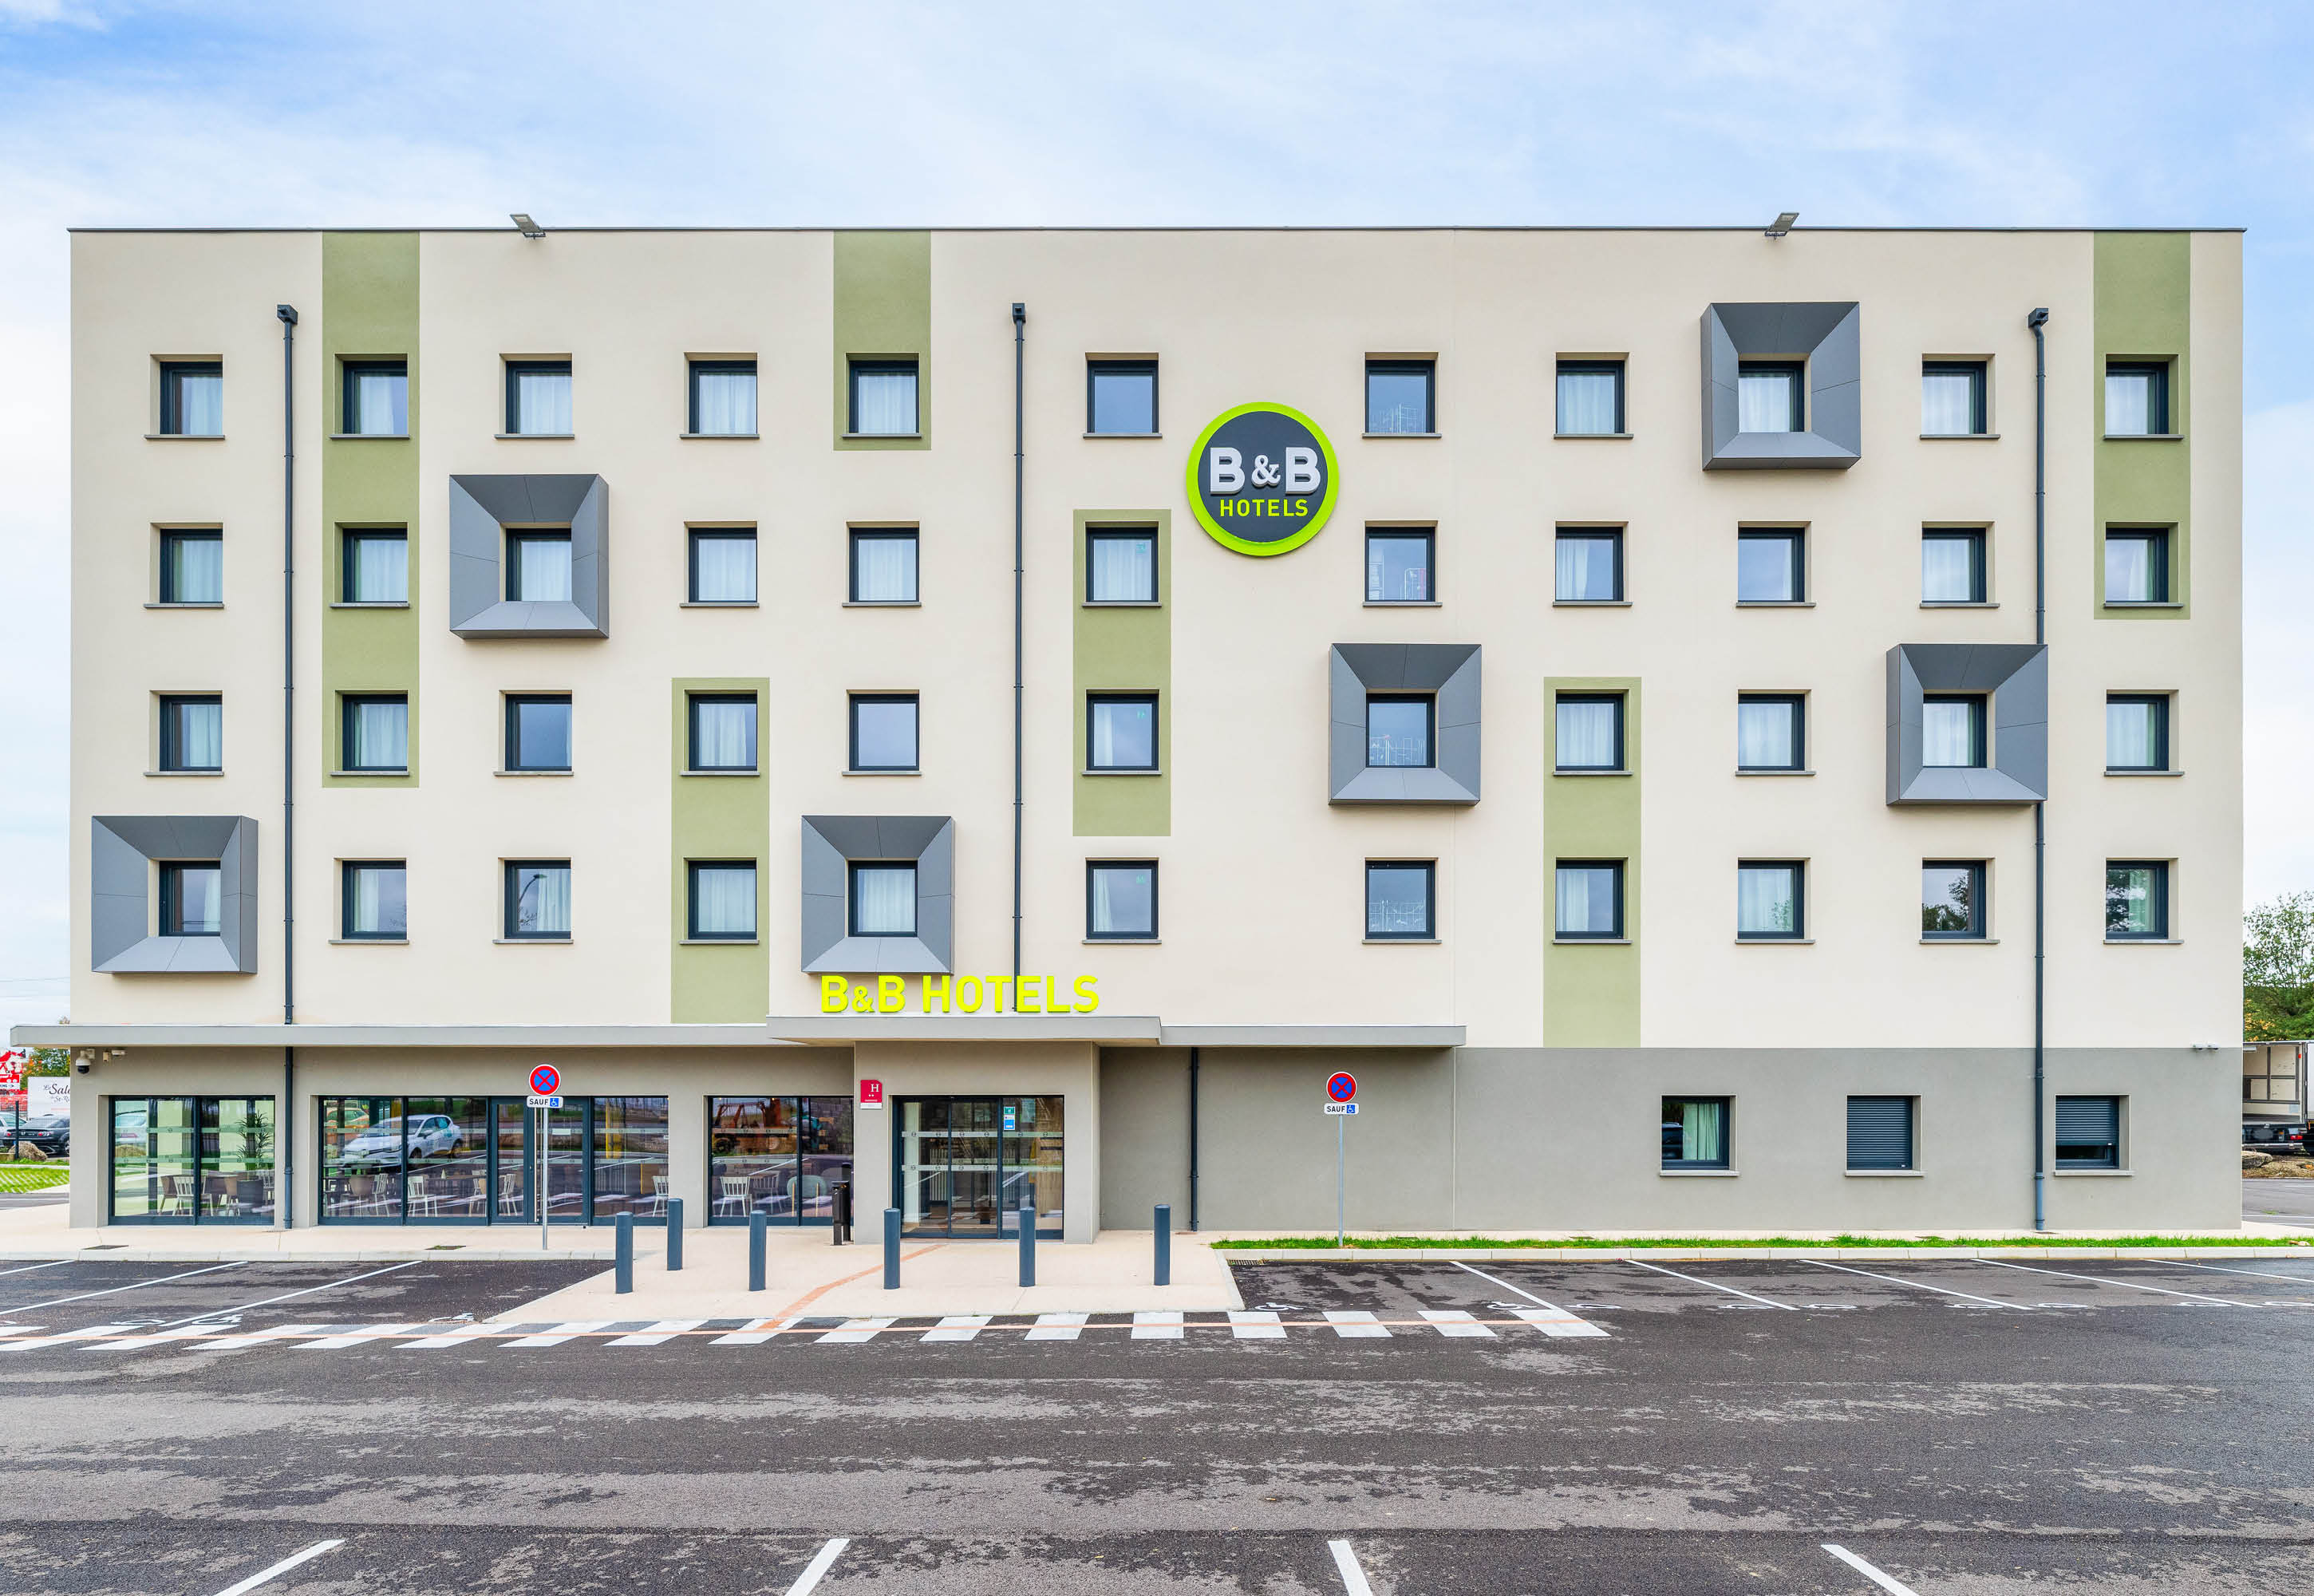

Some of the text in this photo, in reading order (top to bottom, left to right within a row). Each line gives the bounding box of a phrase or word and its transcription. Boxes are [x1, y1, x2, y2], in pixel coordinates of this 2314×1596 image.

[1210, 447, 1321, 495] B&B
[1220, 499, 1309, 517] HOTELS
[821, 975, 1100, 1013] B&B HOTELS
[871, 1084, 880, 1092] H
